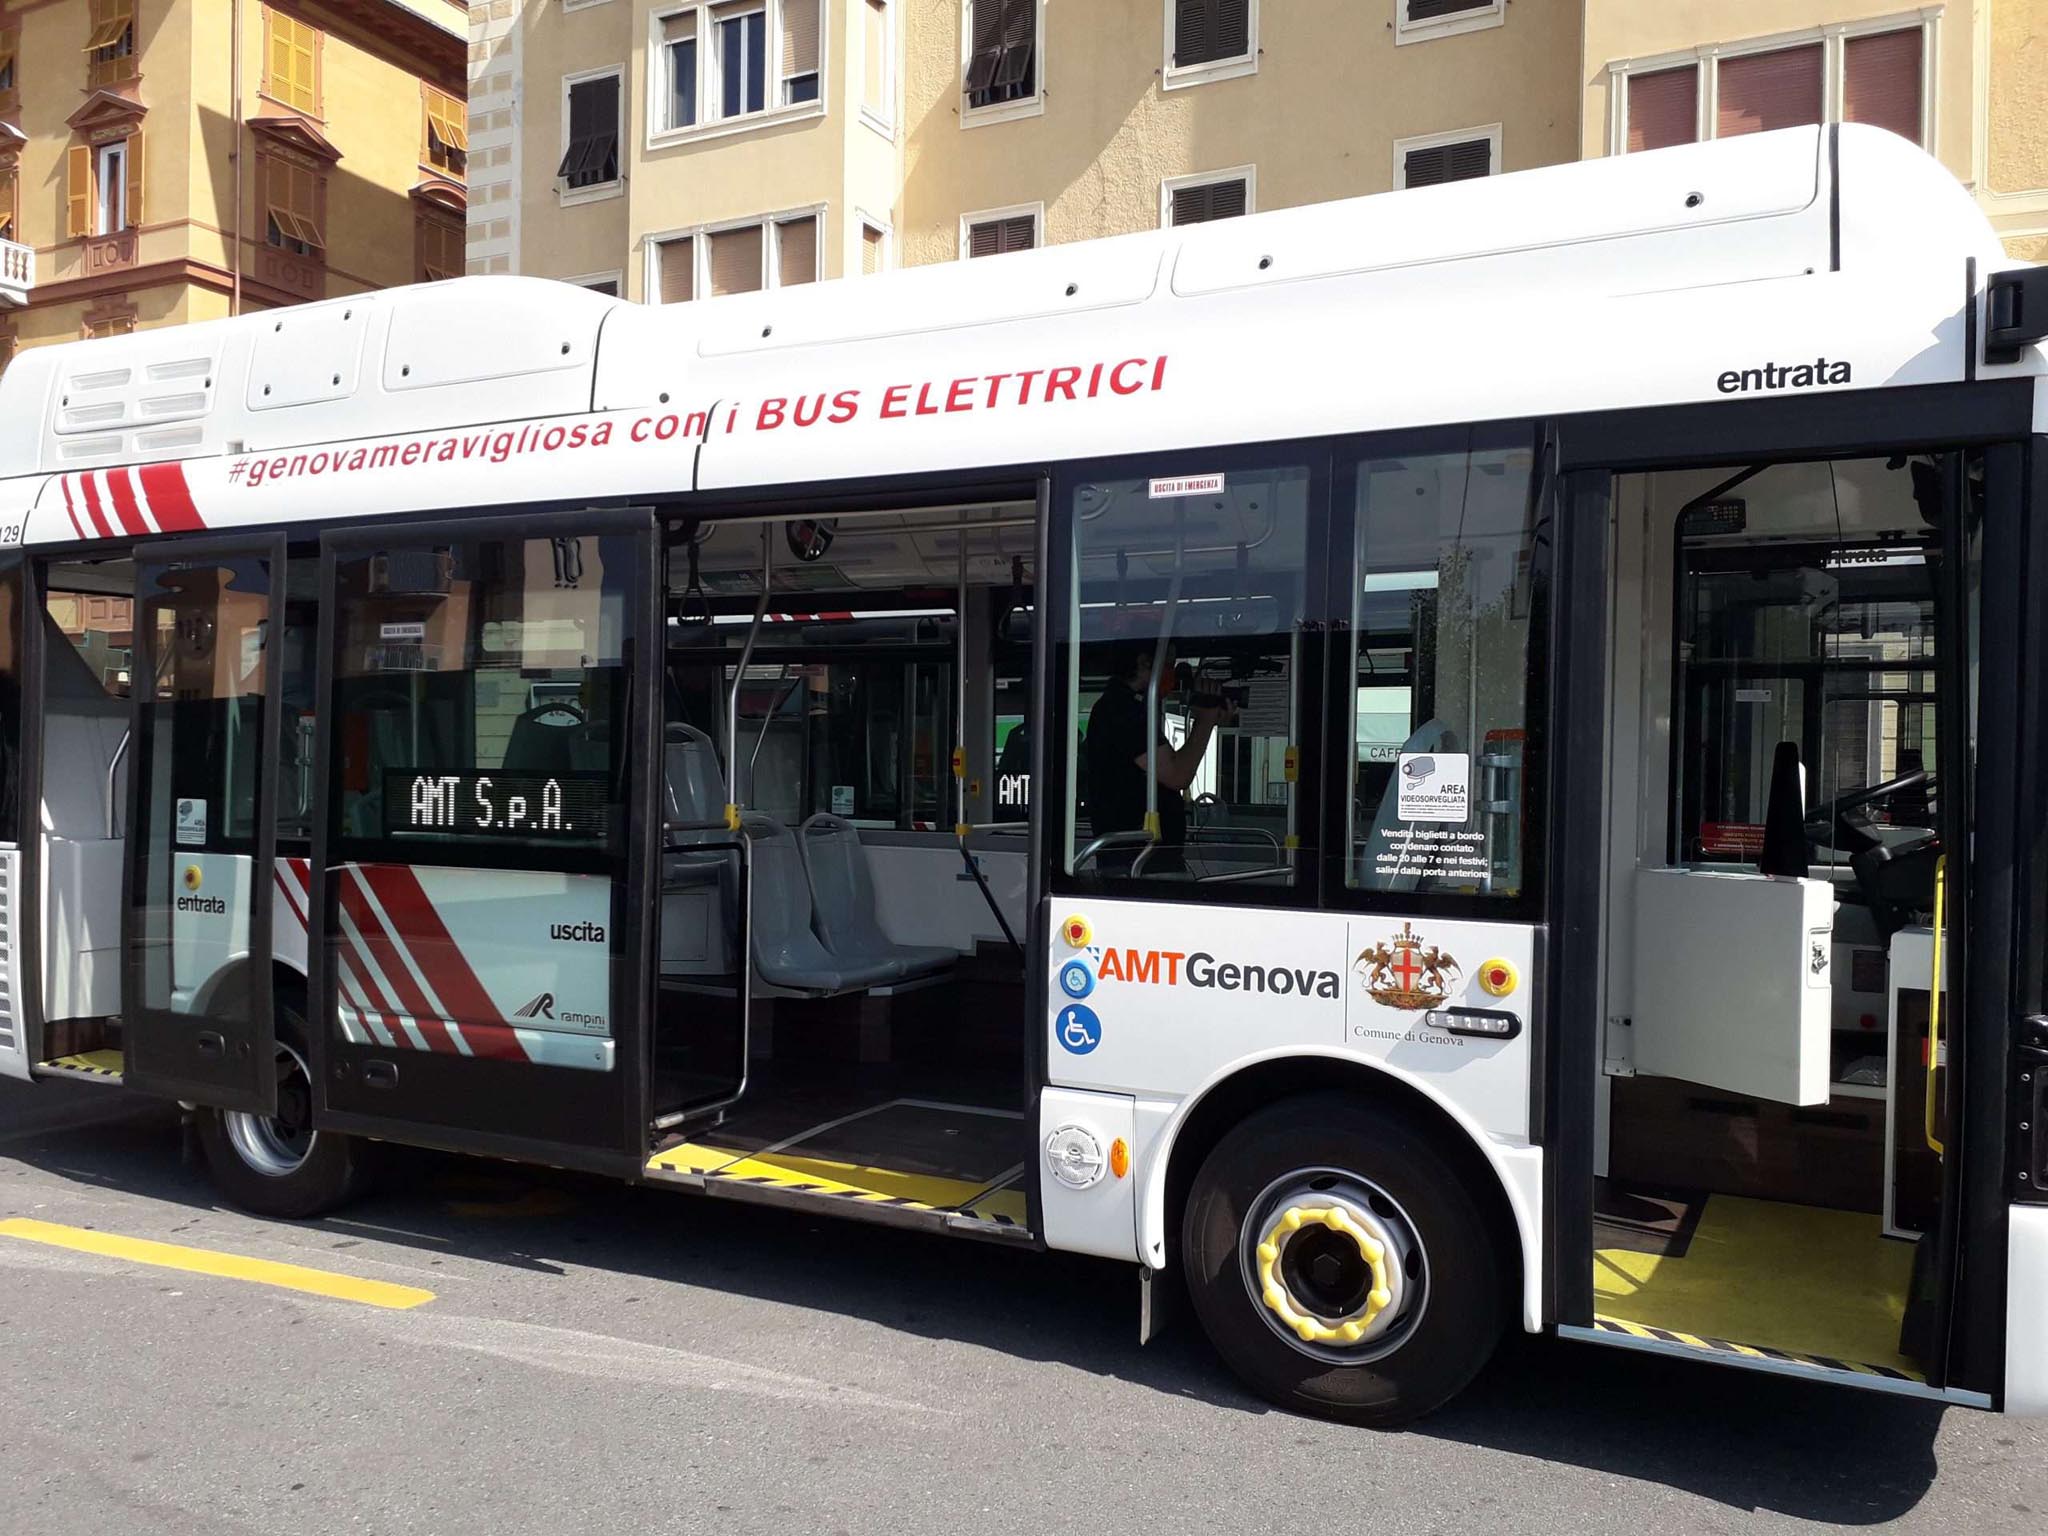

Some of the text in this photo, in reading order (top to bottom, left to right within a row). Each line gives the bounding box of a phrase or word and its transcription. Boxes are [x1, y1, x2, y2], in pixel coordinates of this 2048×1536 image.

[1717, 357, 1852, 394] entrata
[228, 355, 1168, 488] #genovameravigliosa con i BUS ELETTRICI
[1154, 479, 1219, 494] USCITA DI EMERGENZA
[998, 774, 1031, 805] AMT
[1400, 794, 1466, 804] VIDEOSORVEGLIATA
[1440, 784, 1466, 795] AREA
[411, 775, 573, 831] AMT S.p.A.
[1381, 828, 1485, 841] Vendita biglietti a bordo
[1390, 841, 1475, 854] con denaro contato
[1376, 852, 1398, 863] dalle
[1400, 854, 1410, 863] 20
[1411, 854, 1428, 864] alle
[1429, 855, 1435, 864] 7
[1436, 857, 1443, 865] e
[1444, 855, 1458, 866] nei
[1375, 865, 1490, 879] salire dalla porta anteriore
[177, 894, 226, 915] entrata
[550, 920, 606, 944] uscita
[1098, 947, 1340, 1000] AMTGenova
[560, 1011, 606, 1029] rampini
[1354, 1025, 1465, 1046] Comune di Genova
